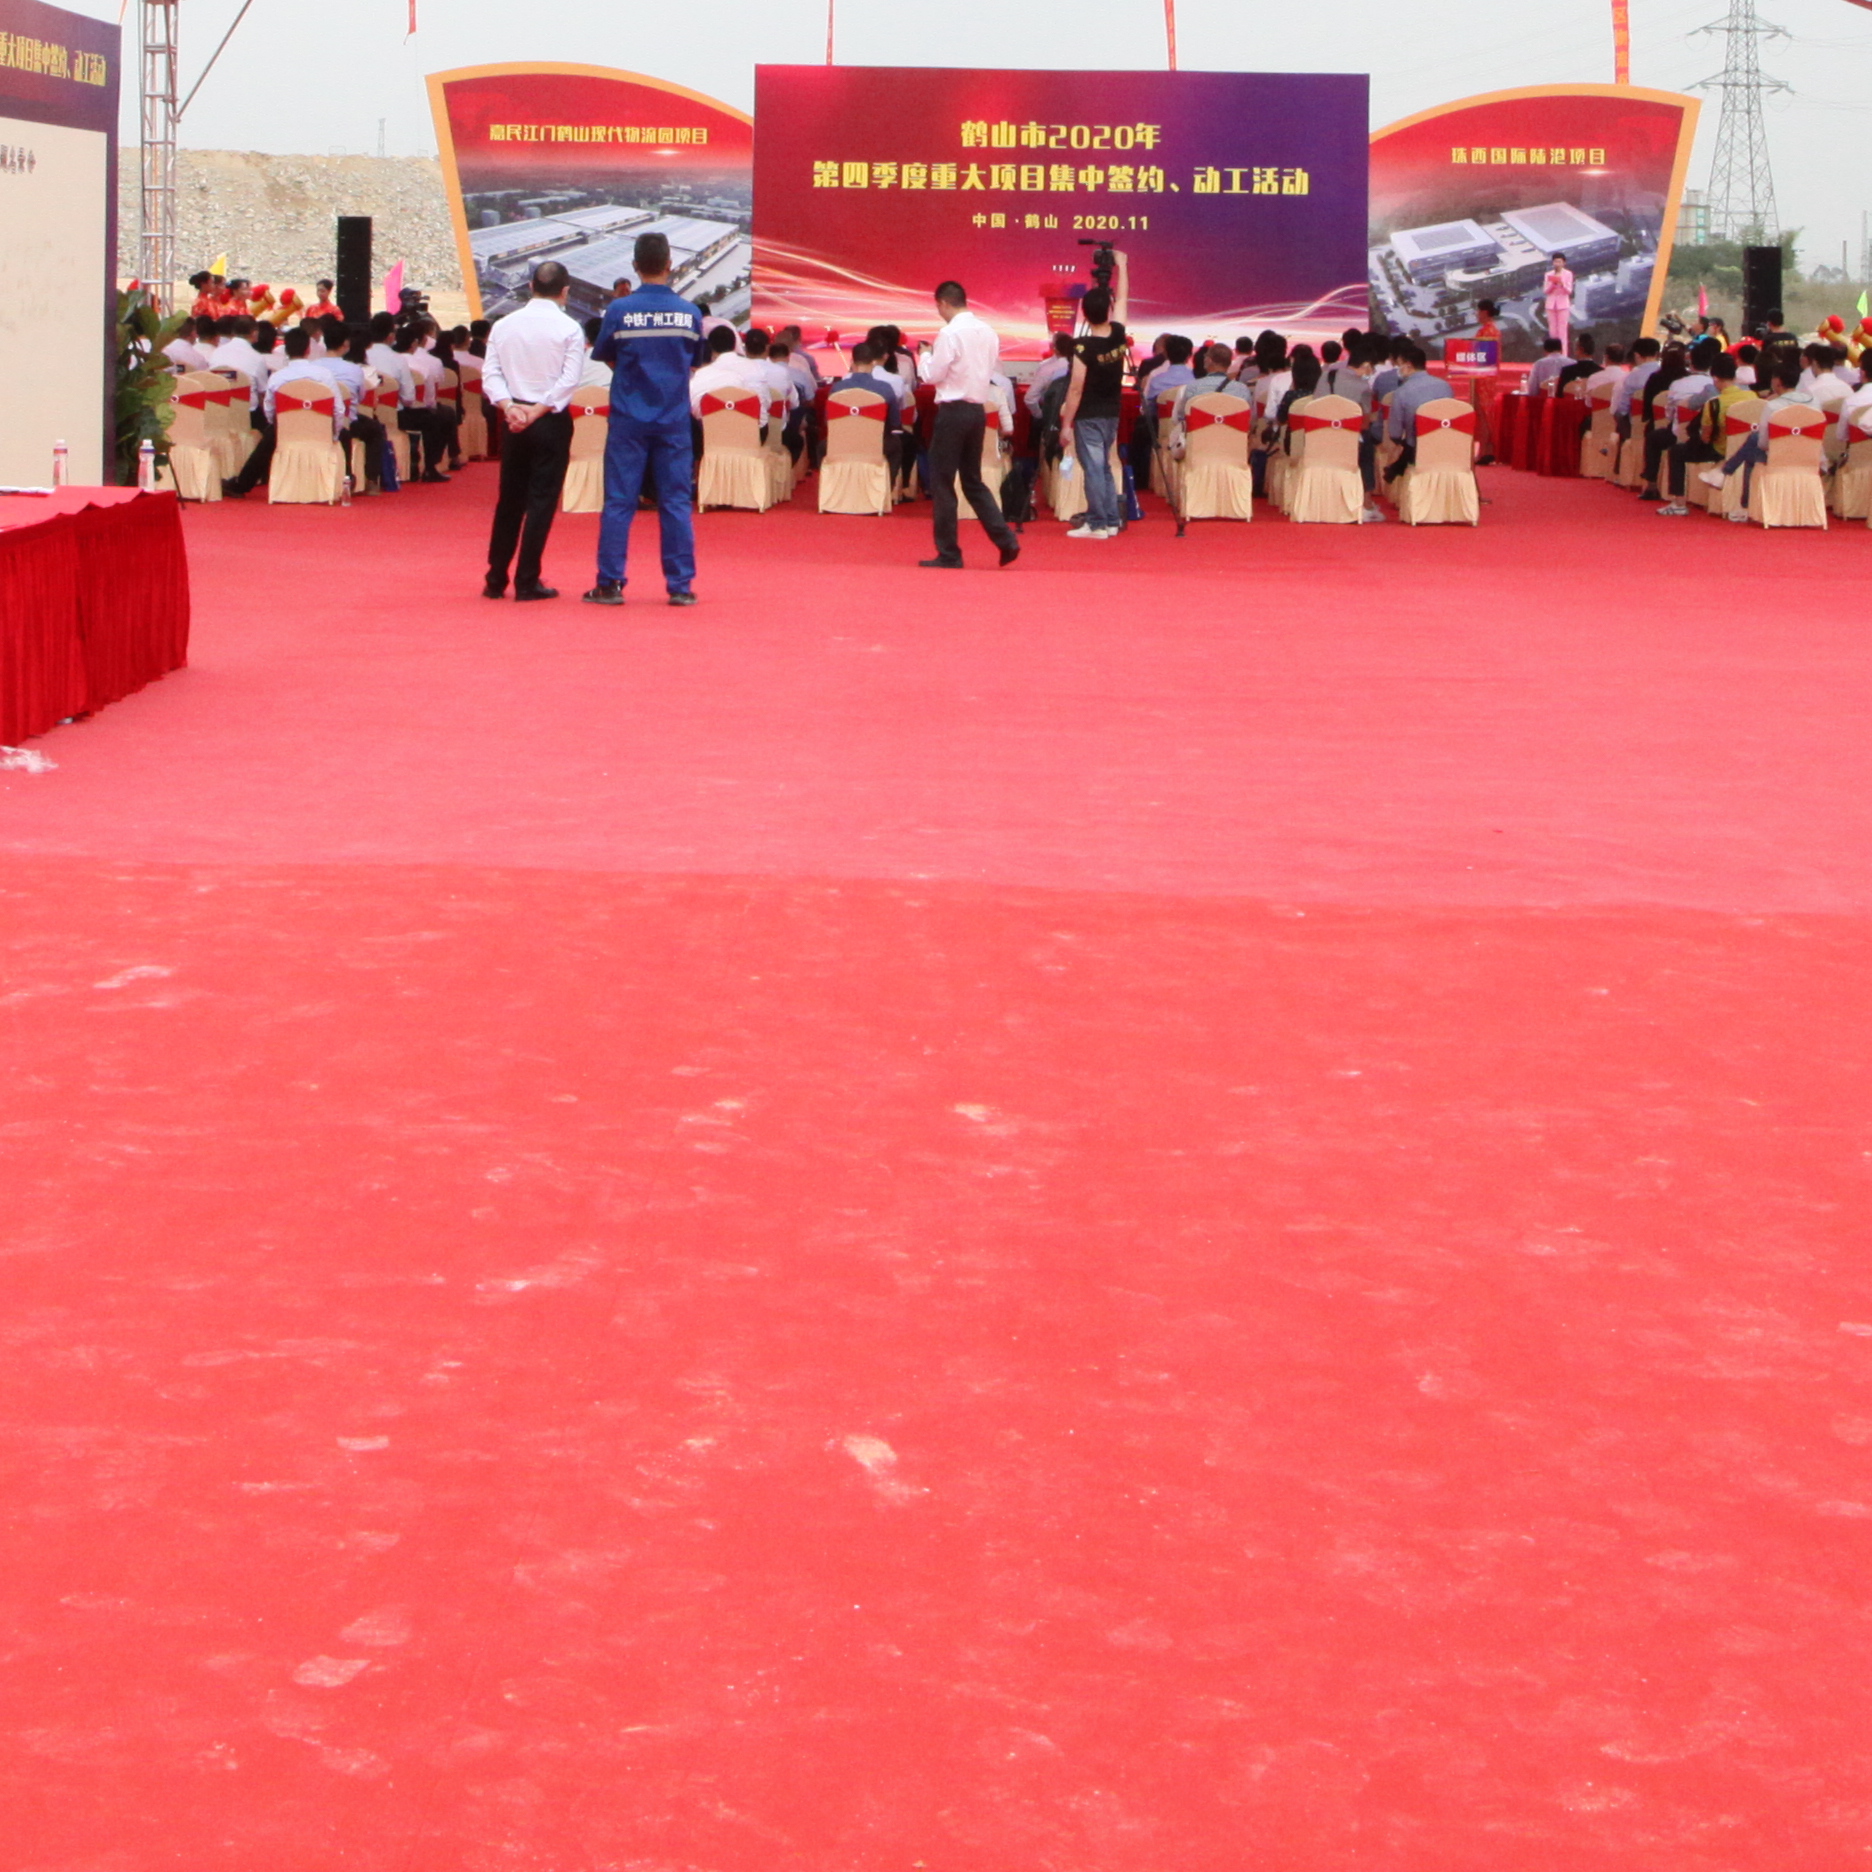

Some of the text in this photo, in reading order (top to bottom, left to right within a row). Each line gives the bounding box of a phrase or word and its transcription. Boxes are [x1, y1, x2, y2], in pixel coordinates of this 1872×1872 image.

[489, 124, 709, 145] 嘉民江门鹤山现代物流园项目
[961, 121, 1162, 149] 鹤山市2020年
[1451, 147, 1606, 165] 珠西国际陆港项目
[813, 160, 1310, 195] 第四季度重大项目集中签约、动工活动
[1073, 215, 1149, 230] 2020.11
[623, 312, 694, 328] 中铁广州工程局
[1455, 351, 1487, 363] 媒体区
